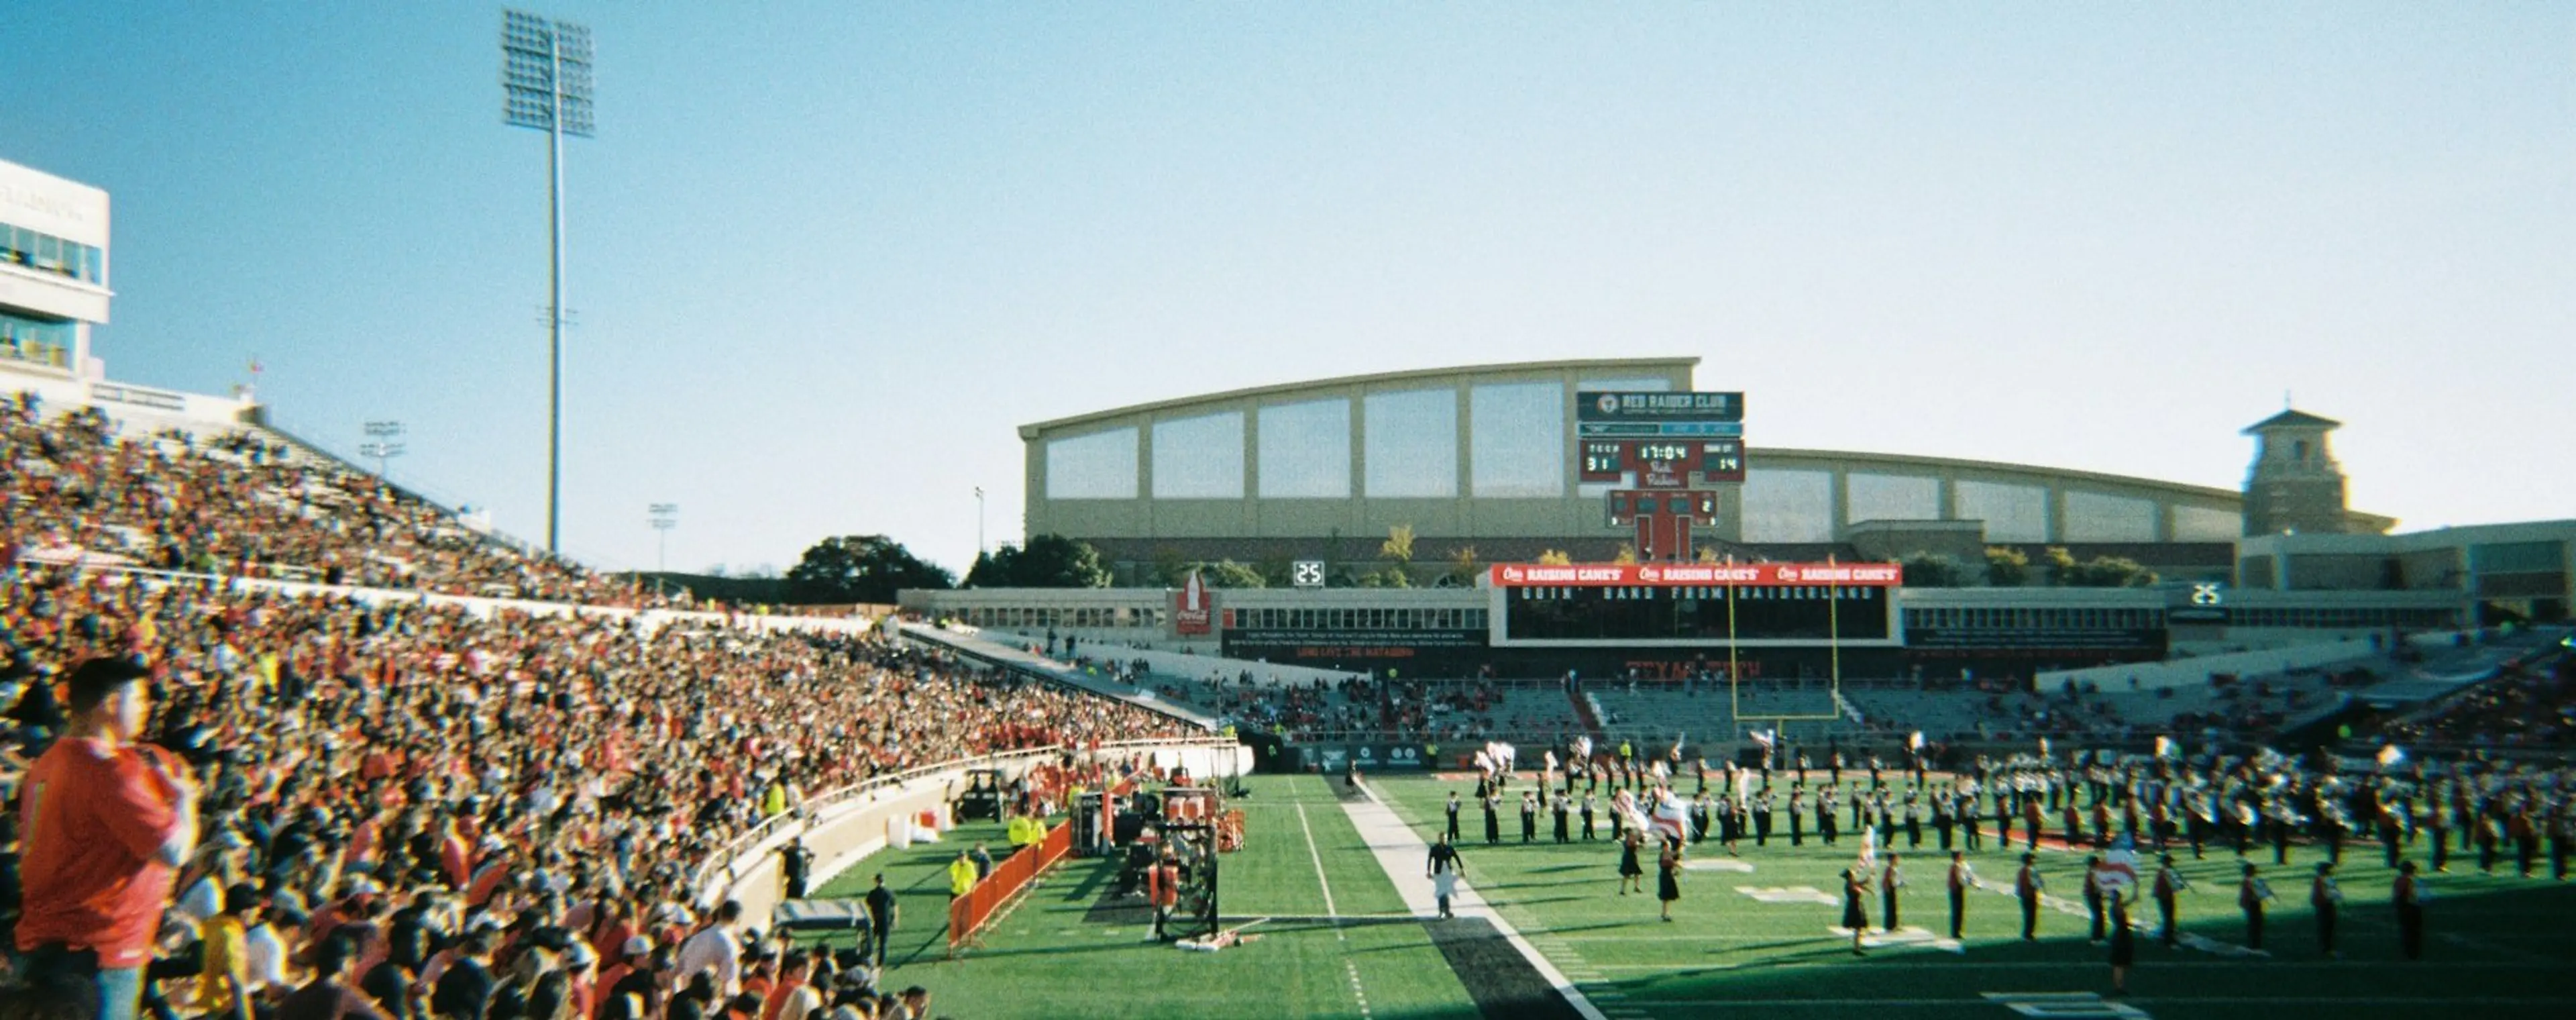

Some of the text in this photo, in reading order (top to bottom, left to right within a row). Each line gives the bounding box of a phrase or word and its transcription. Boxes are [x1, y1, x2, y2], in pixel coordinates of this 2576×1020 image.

[1642, 446, 1686, 460] 17:04
[1587, 456, 1608, 471] 31
[1719, 458, 1737, 470] 14
[1297, 564, 1321, 582] 25
[1527, 568, 1576, 581] RAISING
[1663, 568, 1712, 581] RAISING
[2192, 584, 2220, 604] 25
